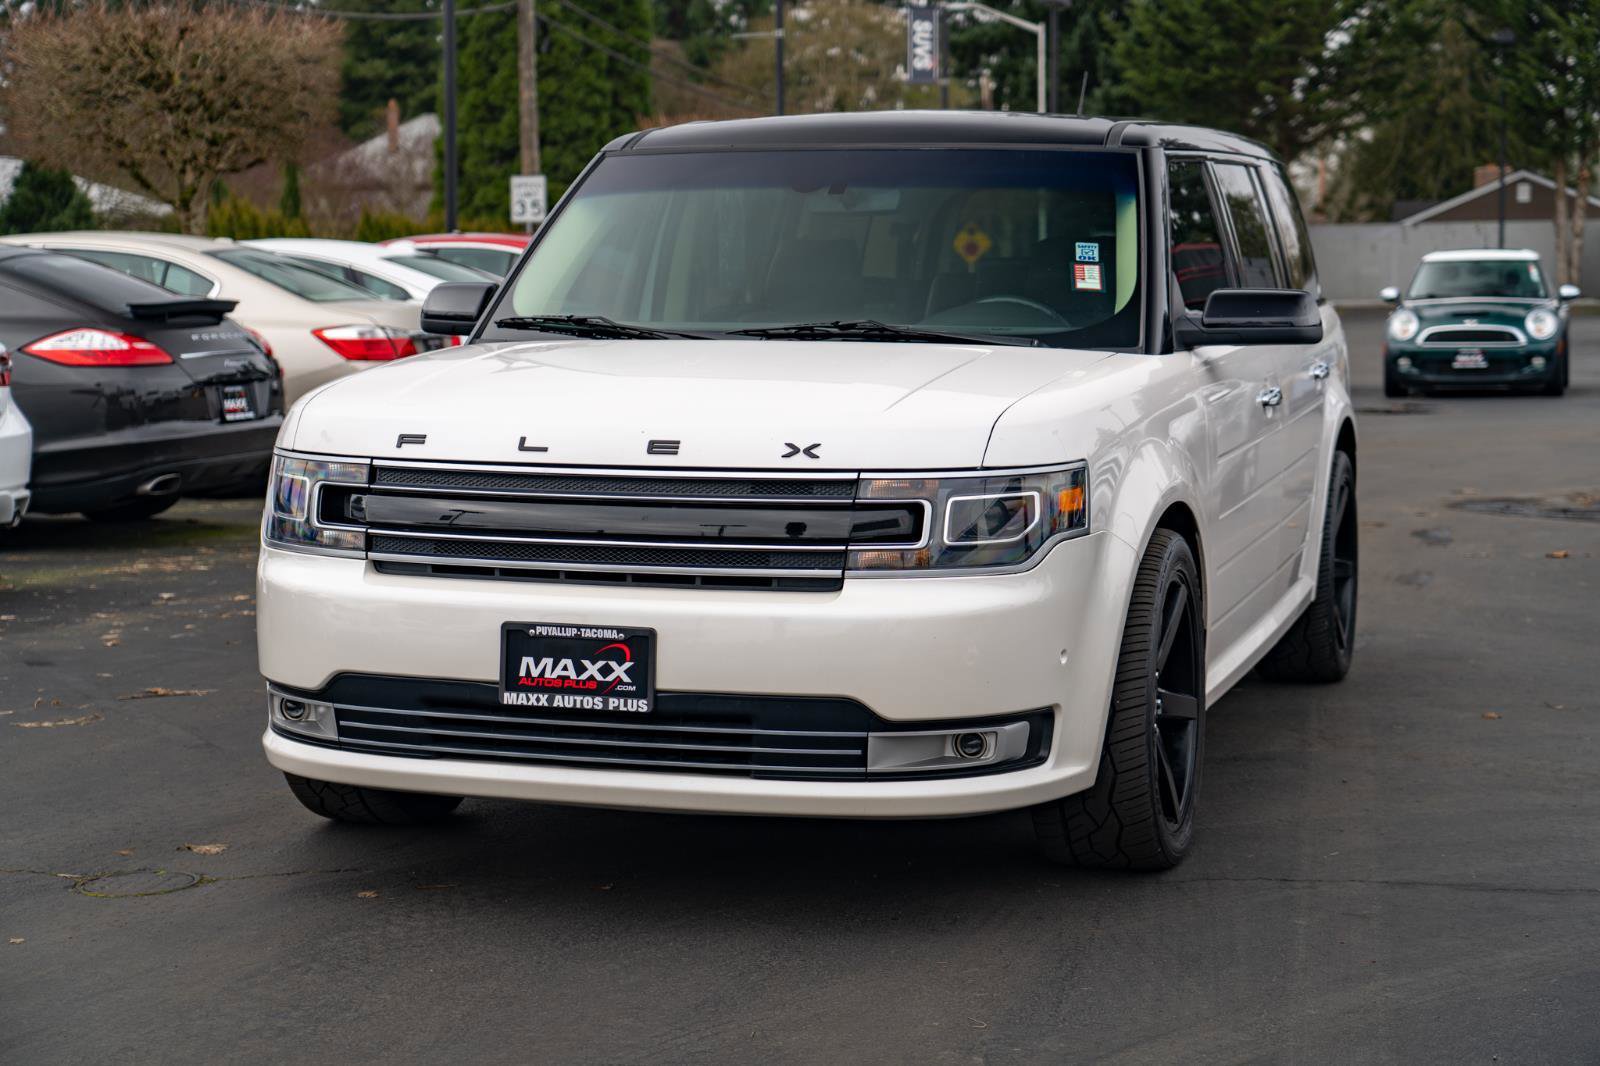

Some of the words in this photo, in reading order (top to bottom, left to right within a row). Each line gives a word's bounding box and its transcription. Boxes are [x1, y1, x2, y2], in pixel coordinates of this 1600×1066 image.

[515, 200, 541, 217] 35
[396, 433, 821, 459] FLEX
[518, 656, 635, 683] MAXX
[518, 677, 562, 688] AUTOS
[564, 679, 597, 689] PLUS
[503, 692, 549, 707] MAXX
[553, 695, 603, 710] AUTOS
[608, 697, 648, 712] PLUS
